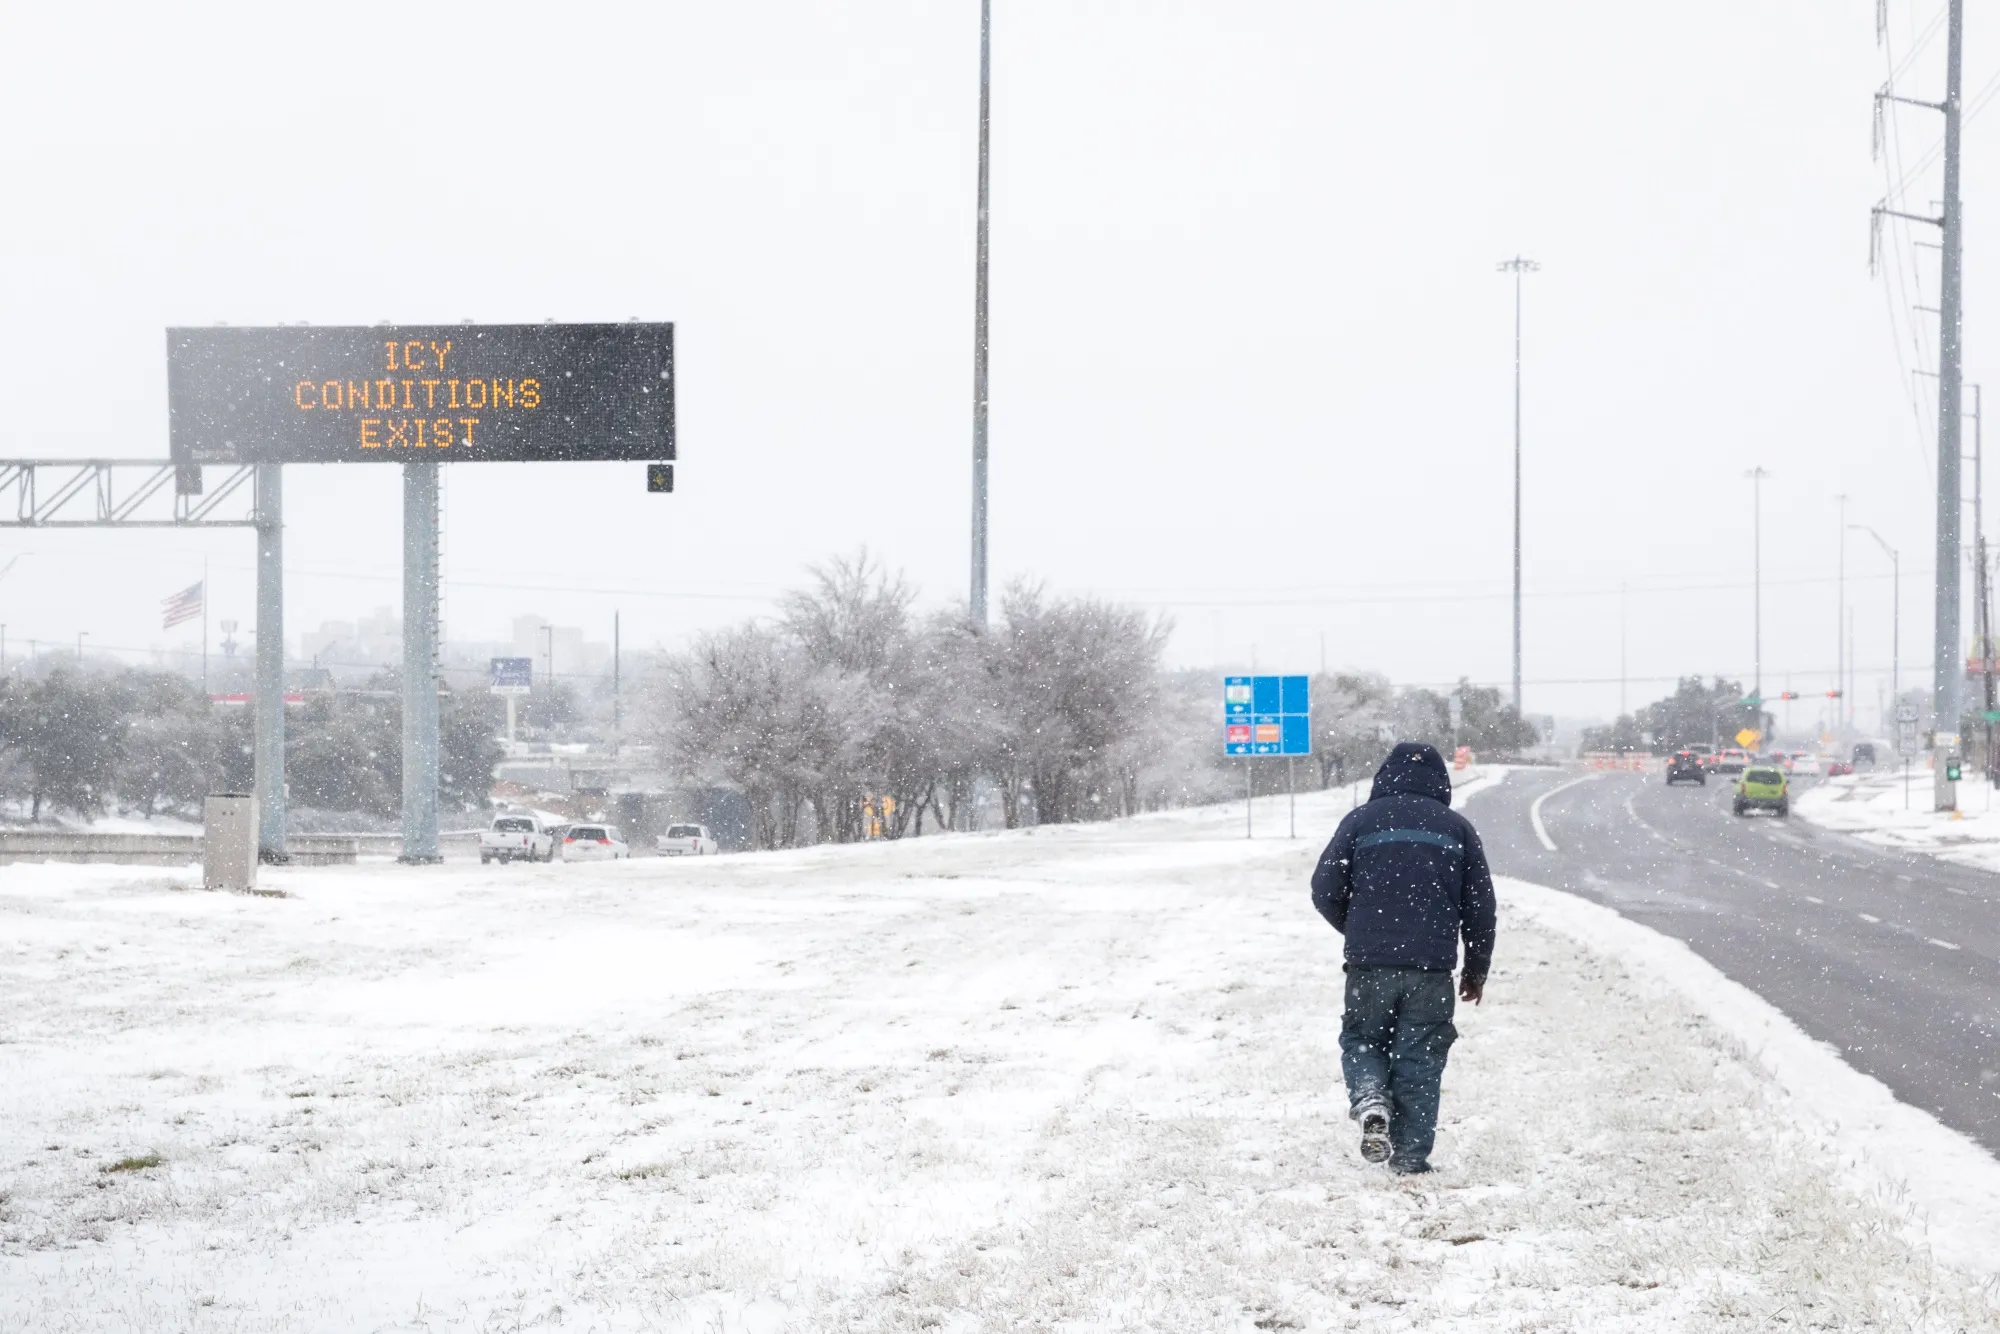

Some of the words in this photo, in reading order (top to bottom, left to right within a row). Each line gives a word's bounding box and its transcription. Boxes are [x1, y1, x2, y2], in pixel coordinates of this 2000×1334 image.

[385, 341, 452, 371] ICY
[295, 378, 541, 409] CONDITIONS
[360, 417, 480, 448] EXIST
